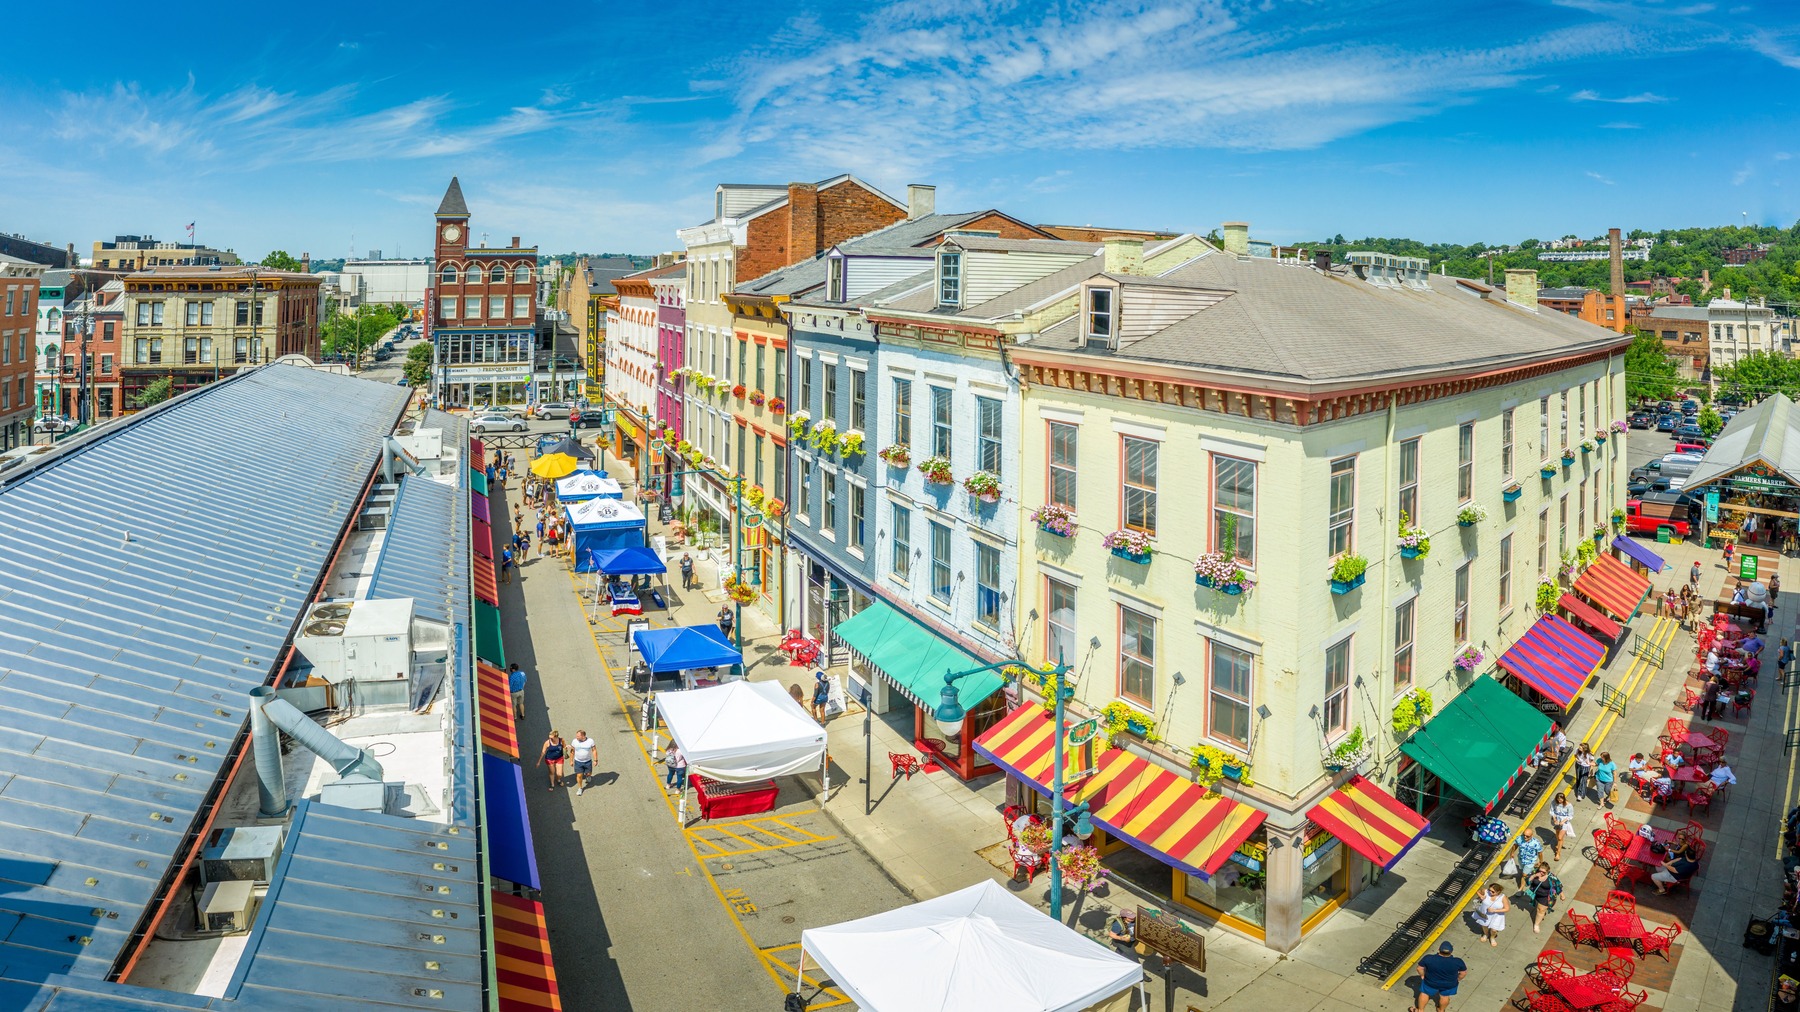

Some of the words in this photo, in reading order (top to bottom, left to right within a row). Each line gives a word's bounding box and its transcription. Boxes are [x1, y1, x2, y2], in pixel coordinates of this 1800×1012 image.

[587, 306, 595, 378] LEADER
[1734, 475, 1762, 484] FARMERS
[1762, 478, 1787, 486] MARKET
[1541, 703, 1558, 711] CHEESES
